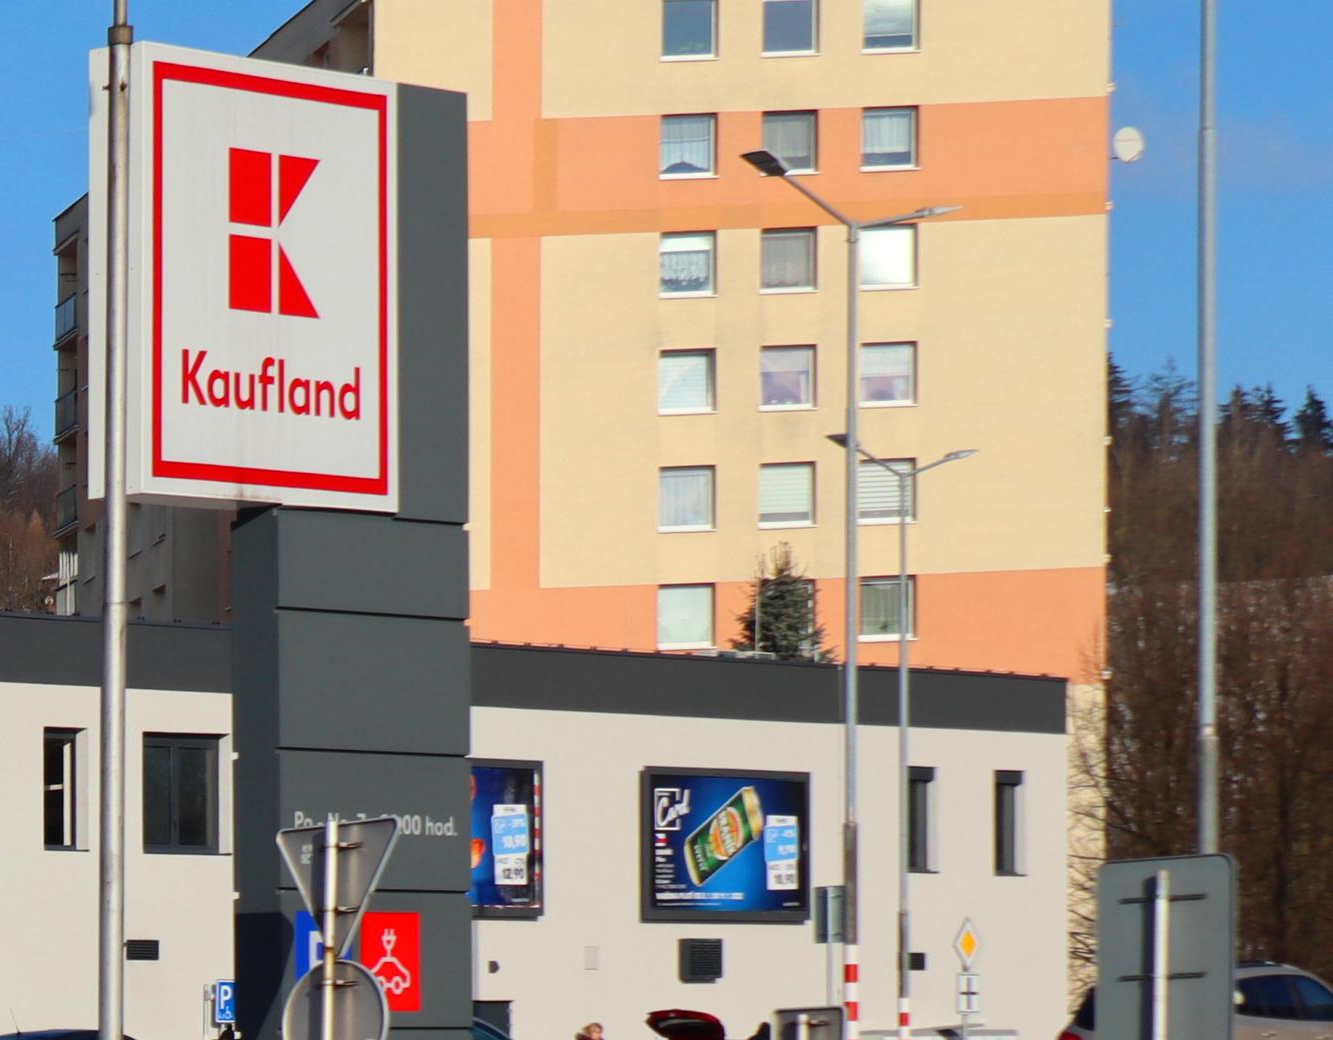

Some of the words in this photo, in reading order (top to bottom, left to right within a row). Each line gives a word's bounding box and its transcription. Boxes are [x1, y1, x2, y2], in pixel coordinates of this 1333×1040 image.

[181, 348, 361, 421] Kaufland
[426, 815, 458, 837] hod.
[221, 985, 232, 1009] P
